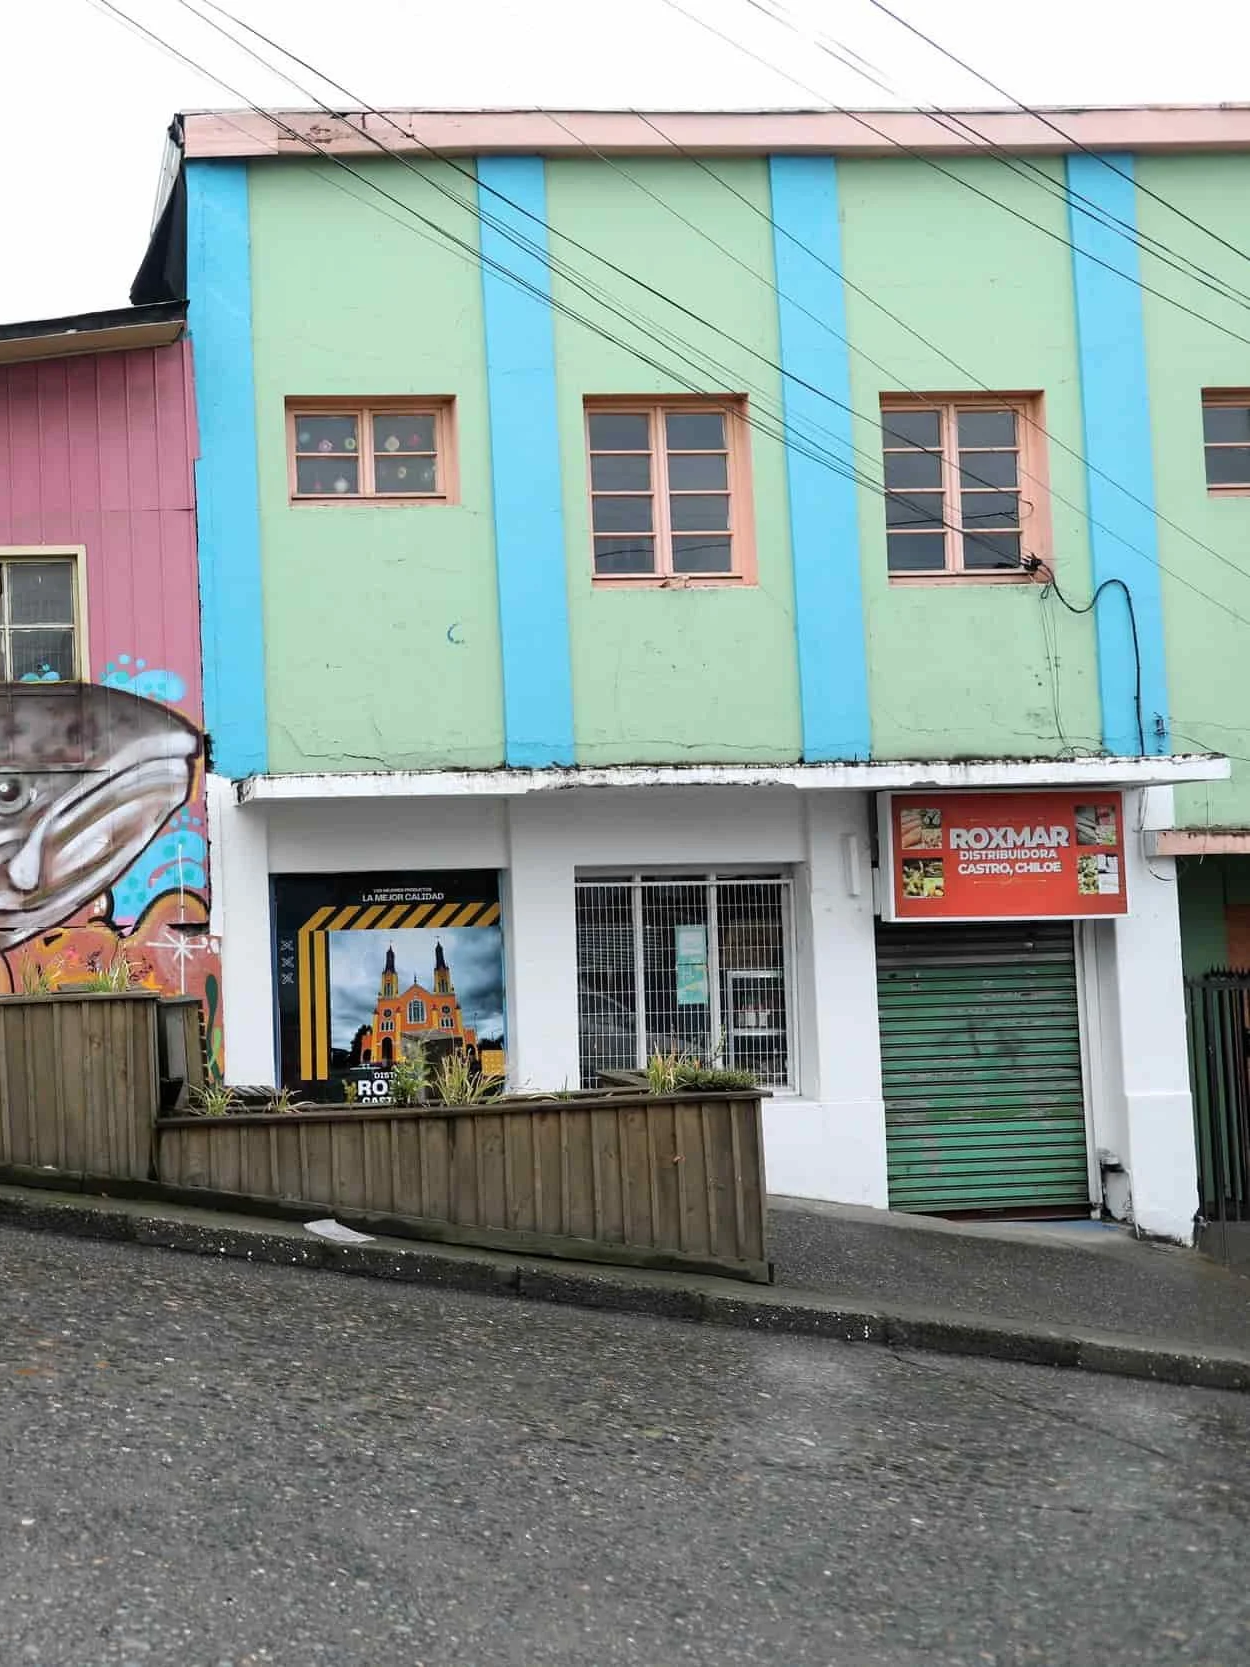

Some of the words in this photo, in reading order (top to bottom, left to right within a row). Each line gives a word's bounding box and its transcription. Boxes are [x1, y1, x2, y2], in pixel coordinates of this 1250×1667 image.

[950, 826, 1069, 849] ROXMAR
[959, 849, 1058, 860] DISTRIBUIDORA
[958, 863, 1014, 876] CASTRO,
[1015, 861, 1062, 873] CHILOE
[362, 894, 374, 902] LA
[375, 893, 403, 902] MEJOR
[405, 893, 444, 901] CALIDAD
